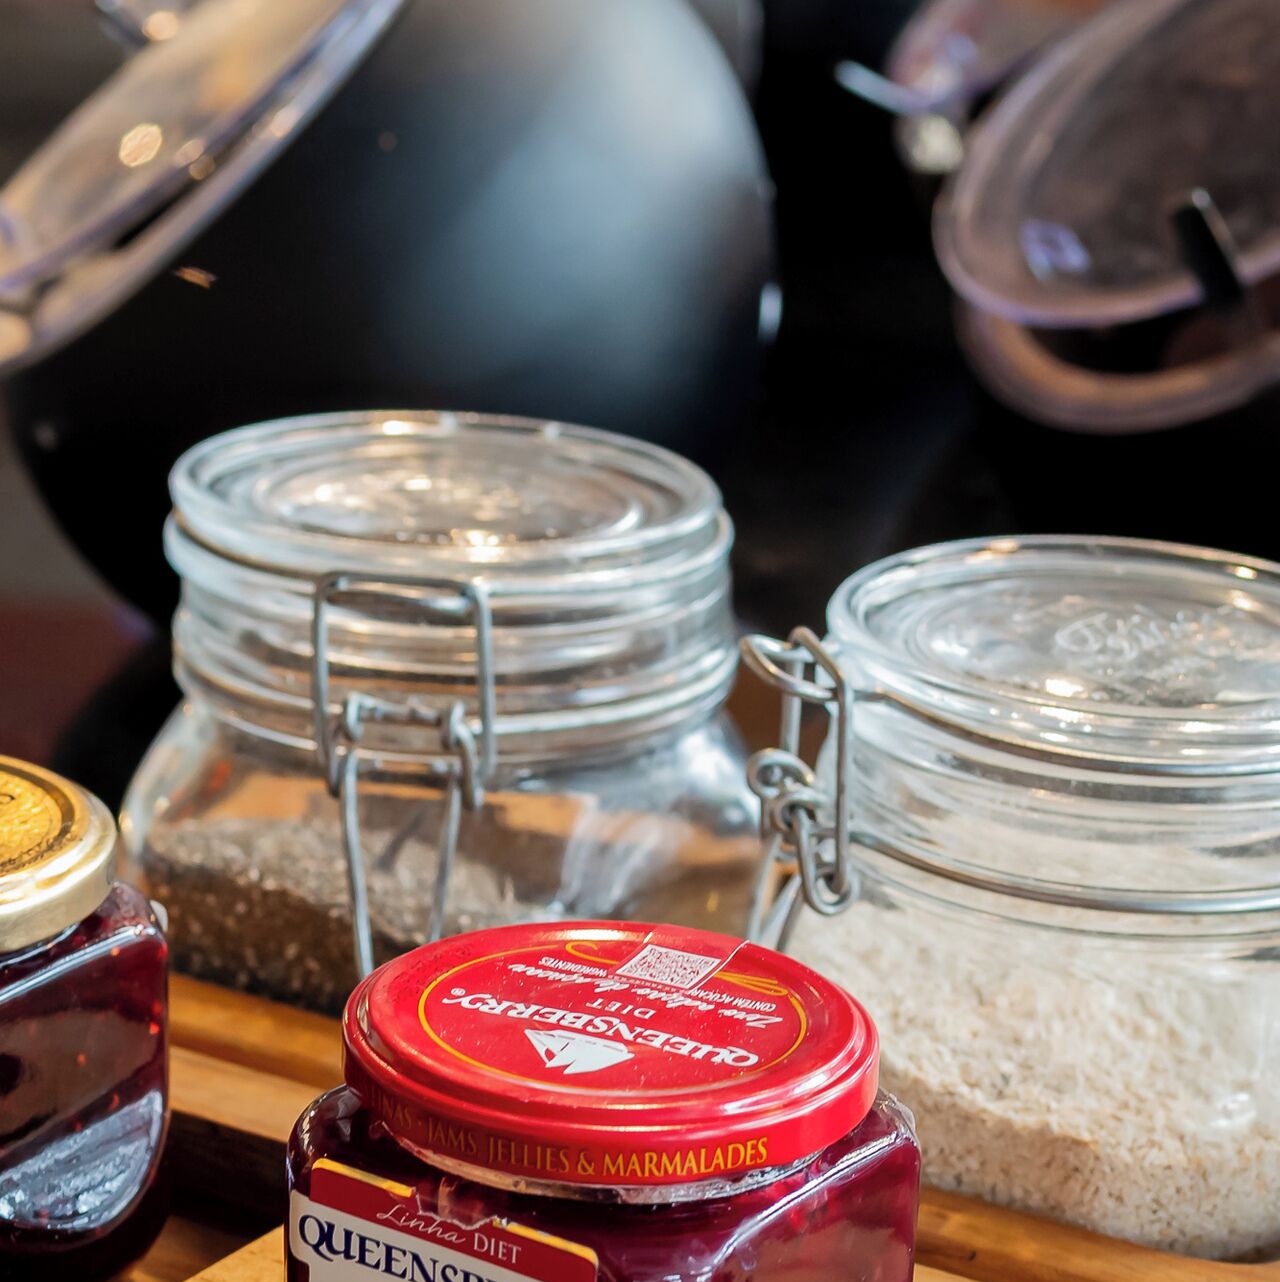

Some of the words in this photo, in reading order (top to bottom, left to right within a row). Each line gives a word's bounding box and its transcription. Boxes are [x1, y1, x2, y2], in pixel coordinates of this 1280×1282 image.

[441, 990, 760, 1067] QUEENSBERRY
[586, 997, 658, 1021] DIET
[487, 1134, 570, 1176] JELLIES
[577, 1149, 596, 1176] &
[602, 1136, 769, 1178] MARMALADES
[376, 1203, 466, 1245] Linha
[473, 1232, 522, 1265] DIET
